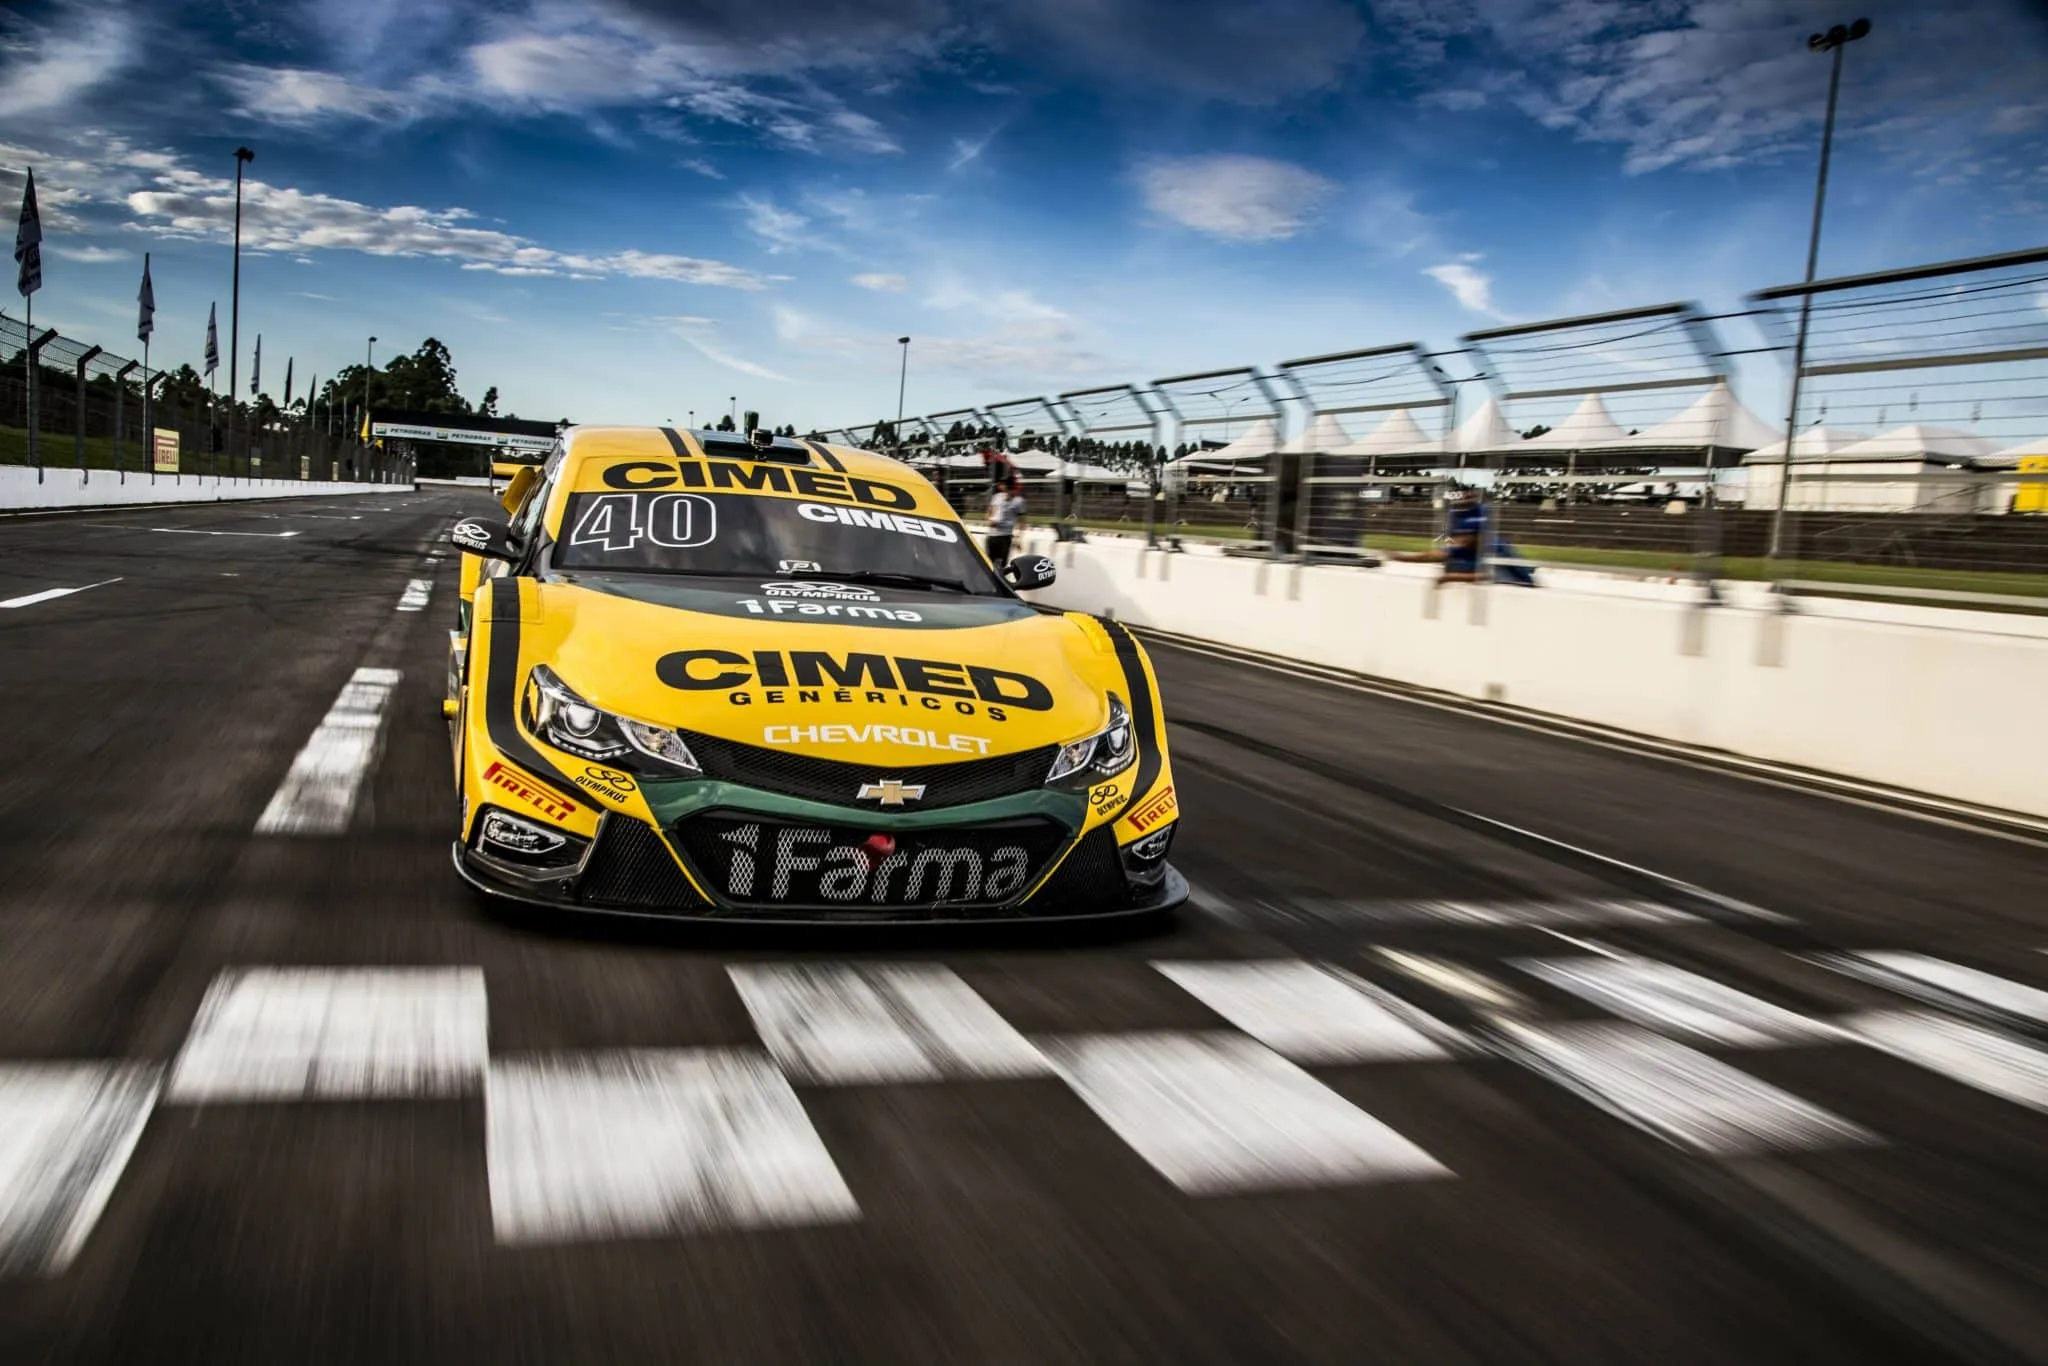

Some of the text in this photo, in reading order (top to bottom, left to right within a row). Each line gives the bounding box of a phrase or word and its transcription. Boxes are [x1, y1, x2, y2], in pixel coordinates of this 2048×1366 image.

[390, 428, 431, 436] PETROBRAS
[451, 433, 491, 441] PETROBRAS
[511, 438, 551, 446] PETROBRAS
[602, 461, 916, 510] CIMED
[570, 493, 716, 551] 40
[797, 504, 957, 543] CIMED
[765, 589, 881, 602] OLYMPIKUS
[656, 649, 1054, 712] CIMED
[729, 688, 1007, 722] GENÉRICOS
[763, 724, 991, 755] CHEVROLET
[482, 762, 576, 821] PIRELLI
[575, 775, 628, 804] OLYMPIKUS
